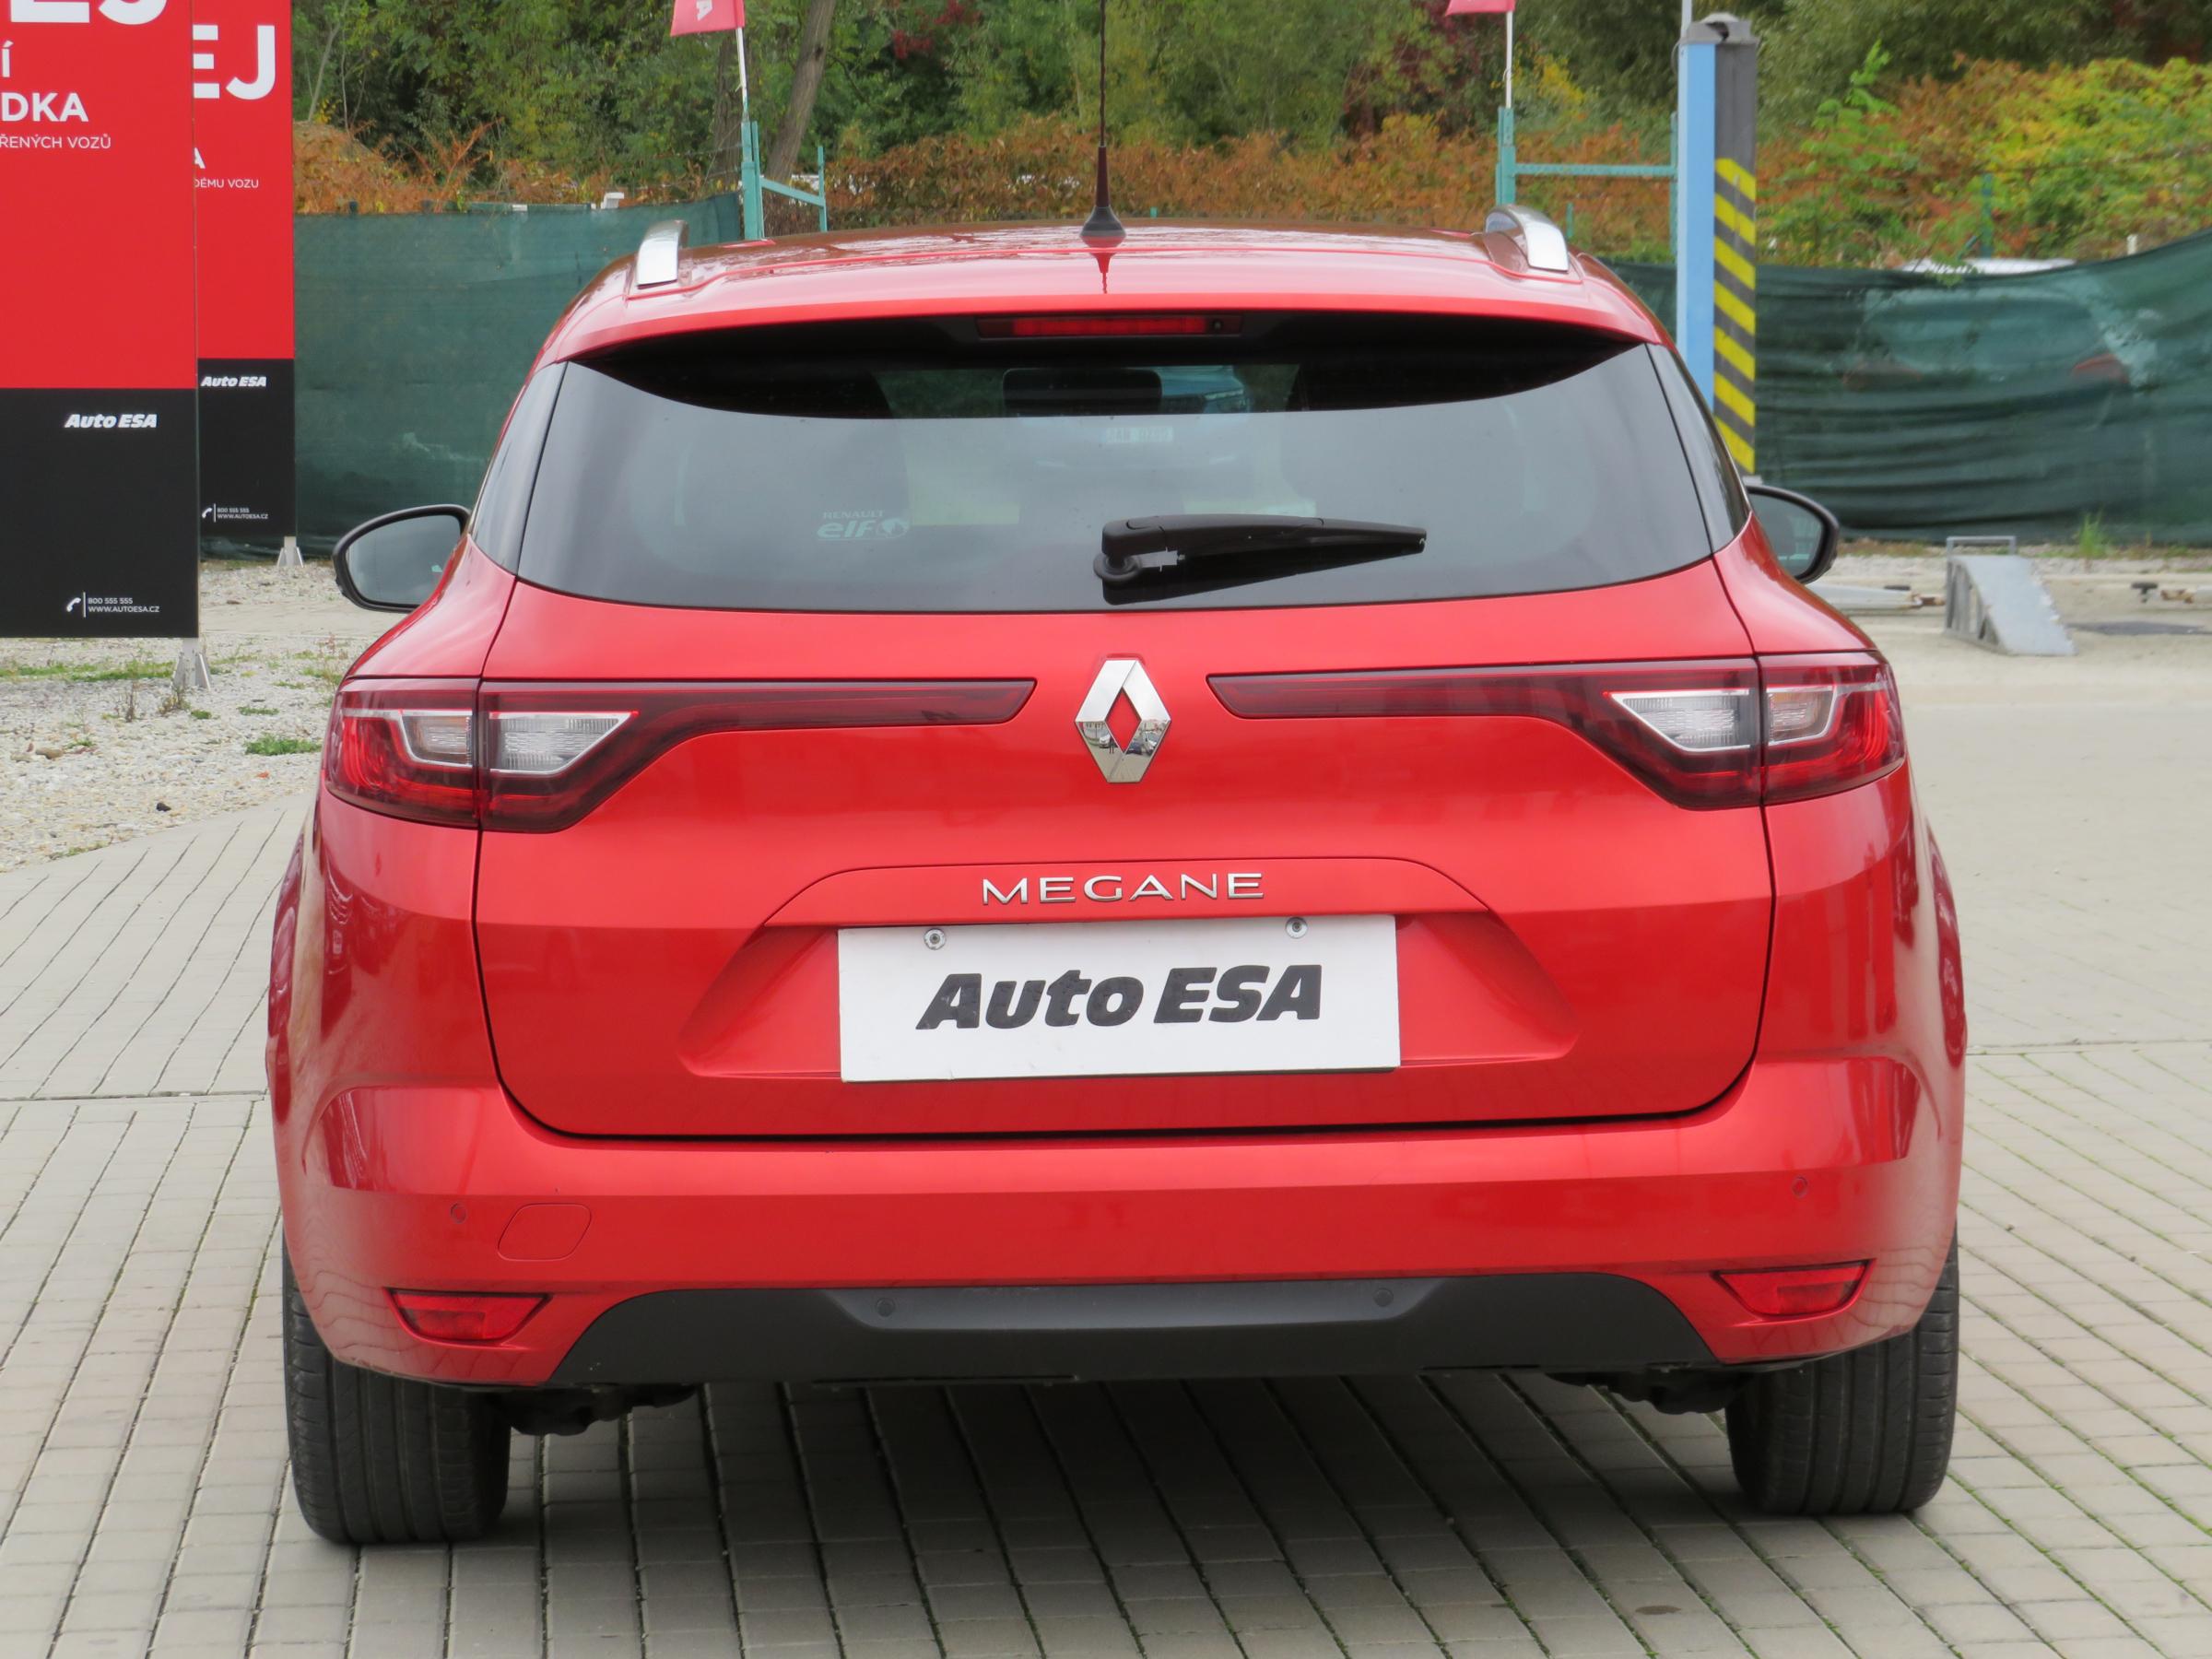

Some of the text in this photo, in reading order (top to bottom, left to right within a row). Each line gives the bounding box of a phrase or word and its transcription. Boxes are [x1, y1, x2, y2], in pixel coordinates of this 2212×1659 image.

[1, 92, 89, 122] DKA
[67, 133, 112, 148] VOZŮ
[228, 179, 259, 189] VOZU
[201, 375, 267, 387] Auto ESA
[64, 414, 158, 429] Auto ESA
[823, 510, 885, 519] RENAULT
[981, 872, 1265, 906] MEGANE
[915, 964, 1323, 1031] Auto ESA
